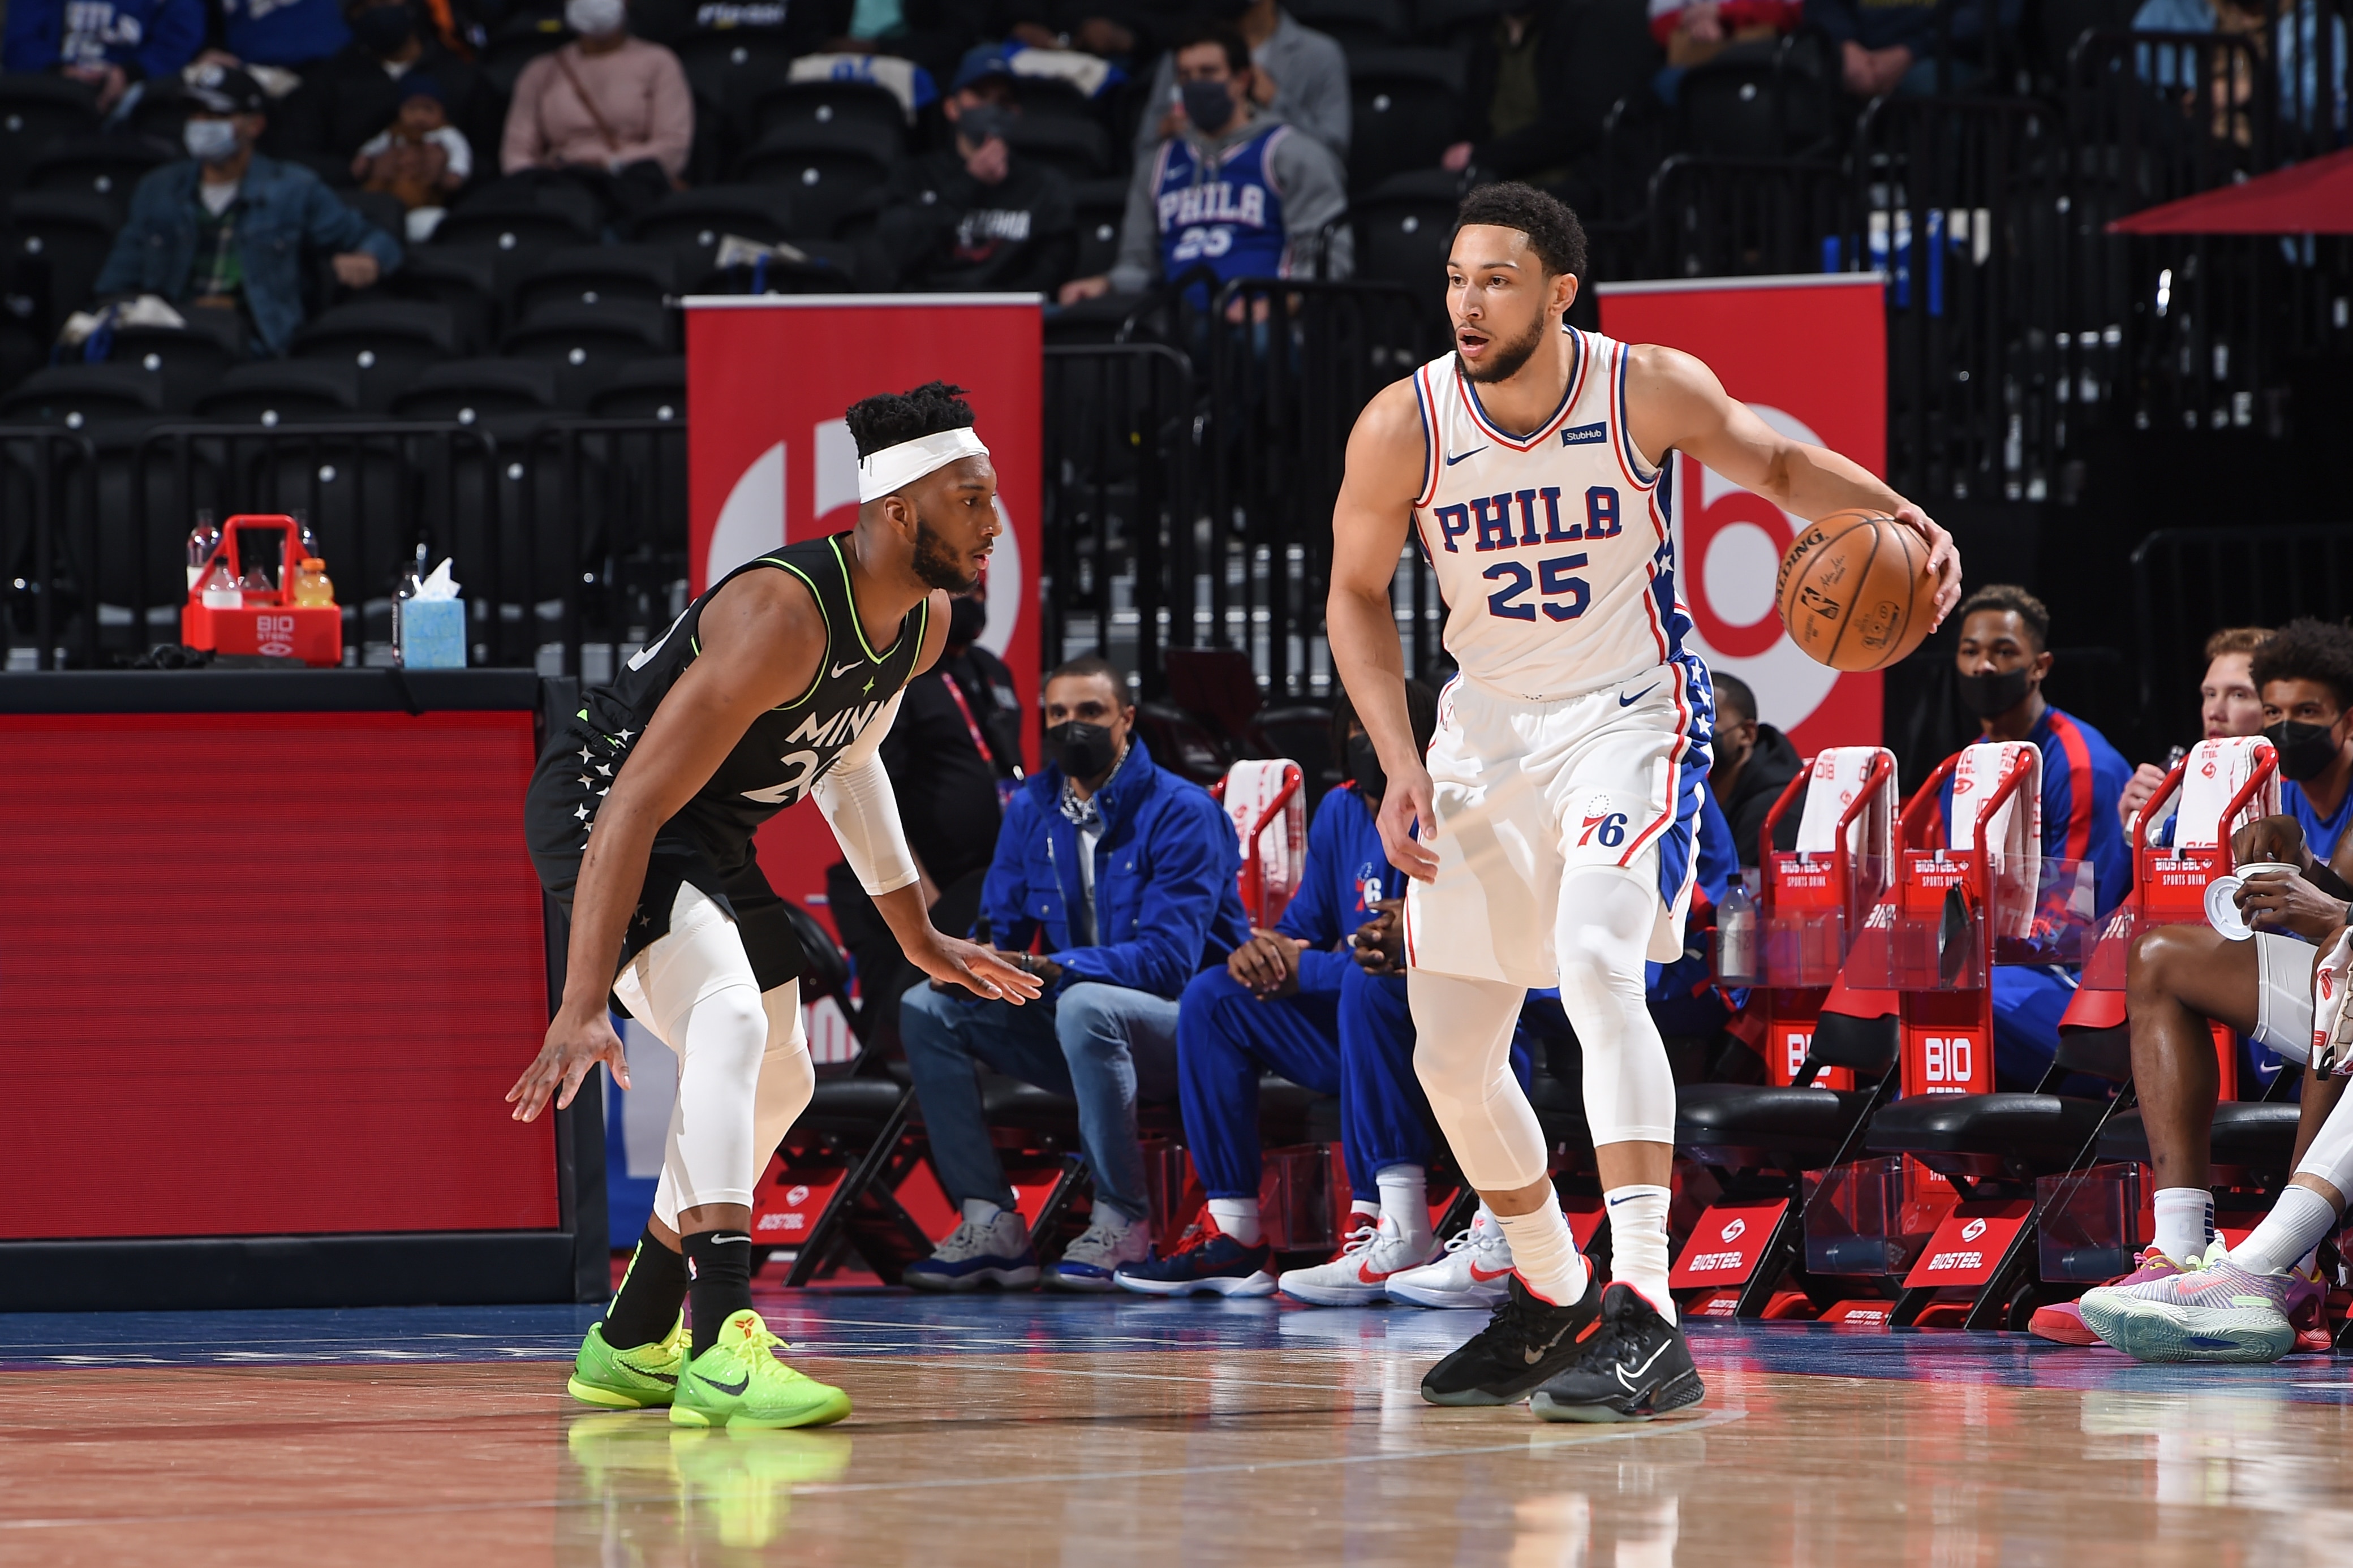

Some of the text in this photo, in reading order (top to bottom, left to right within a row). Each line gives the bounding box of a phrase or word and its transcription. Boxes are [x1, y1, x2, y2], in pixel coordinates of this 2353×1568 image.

[1158, 179, 1266, 234] PHILA
[1567, 429, 1602, 441] StubHub
[1433, 485, 1623, 553] PHILA
[1482, 552, 1590, 622] 25
[257, 615, 294, 632] BIO
[1576, 812, 1628, 847] 76
[1786, 876, 1826, 887] SPORTS DRINK
[1922, 876, 1944, 887] SPORTS
[2162, 874, 2206, 886] SPORTS DRINK
[1925, 1037, 1972, 1082] BIO
[1688, 1251, 1743, 1272] BIOSTEEL
[1928, 1251, 1983, 1270] BIOSTEEL
[1844, 1310, 1883, 1319] BIOSTEEL
